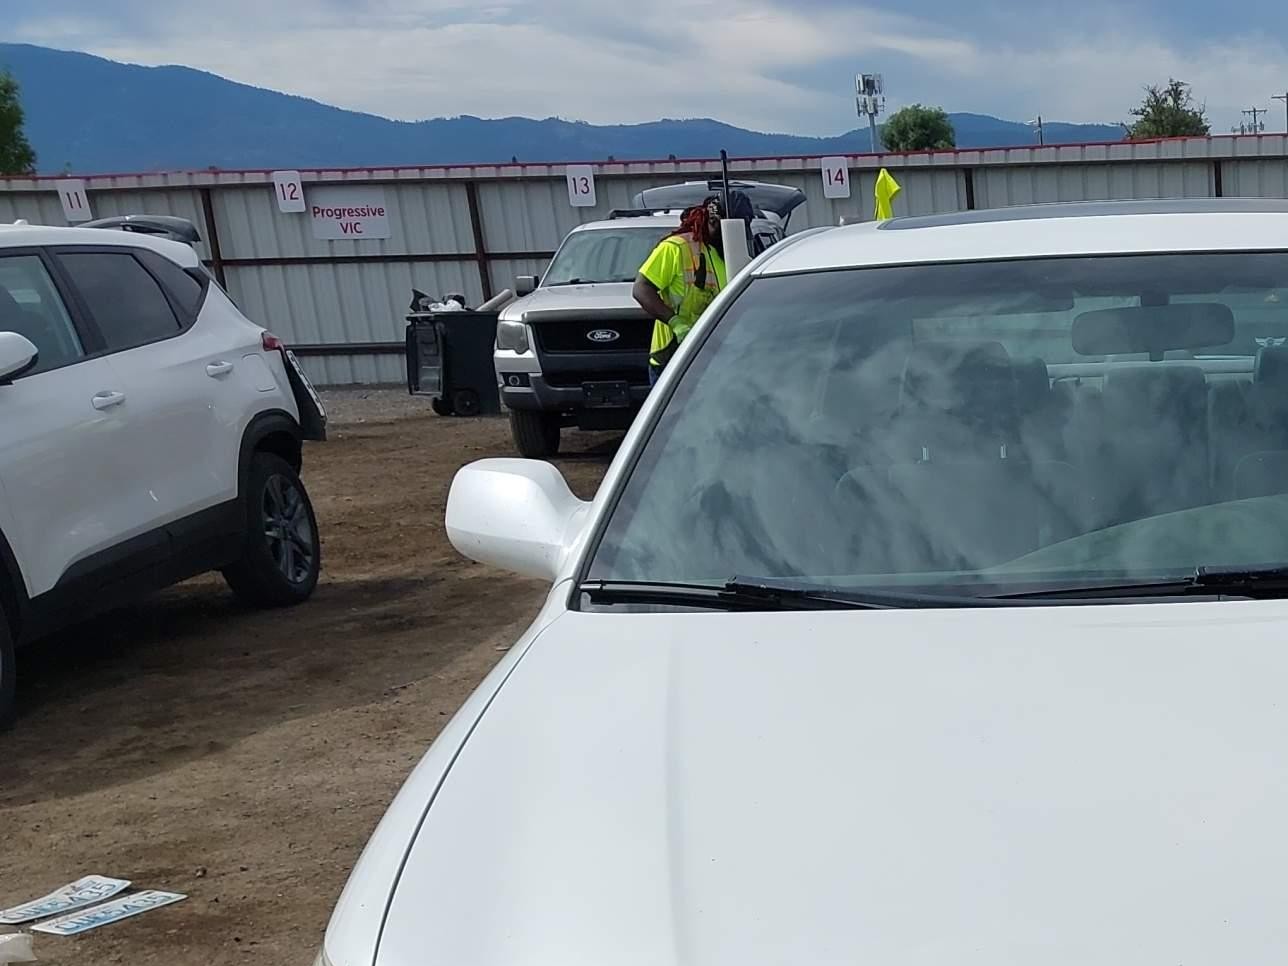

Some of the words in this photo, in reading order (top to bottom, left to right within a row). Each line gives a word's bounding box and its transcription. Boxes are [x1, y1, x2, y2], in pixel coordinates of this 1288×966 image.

[572, 176, 590, 195] 13
[827, 167, 845, 186] 14
[66, 191, 82, 209] 11
[280, 182, 299, 201] 12
[312, 204, 385, 220] Progressive
[340, 222, 363, 234] VIC
